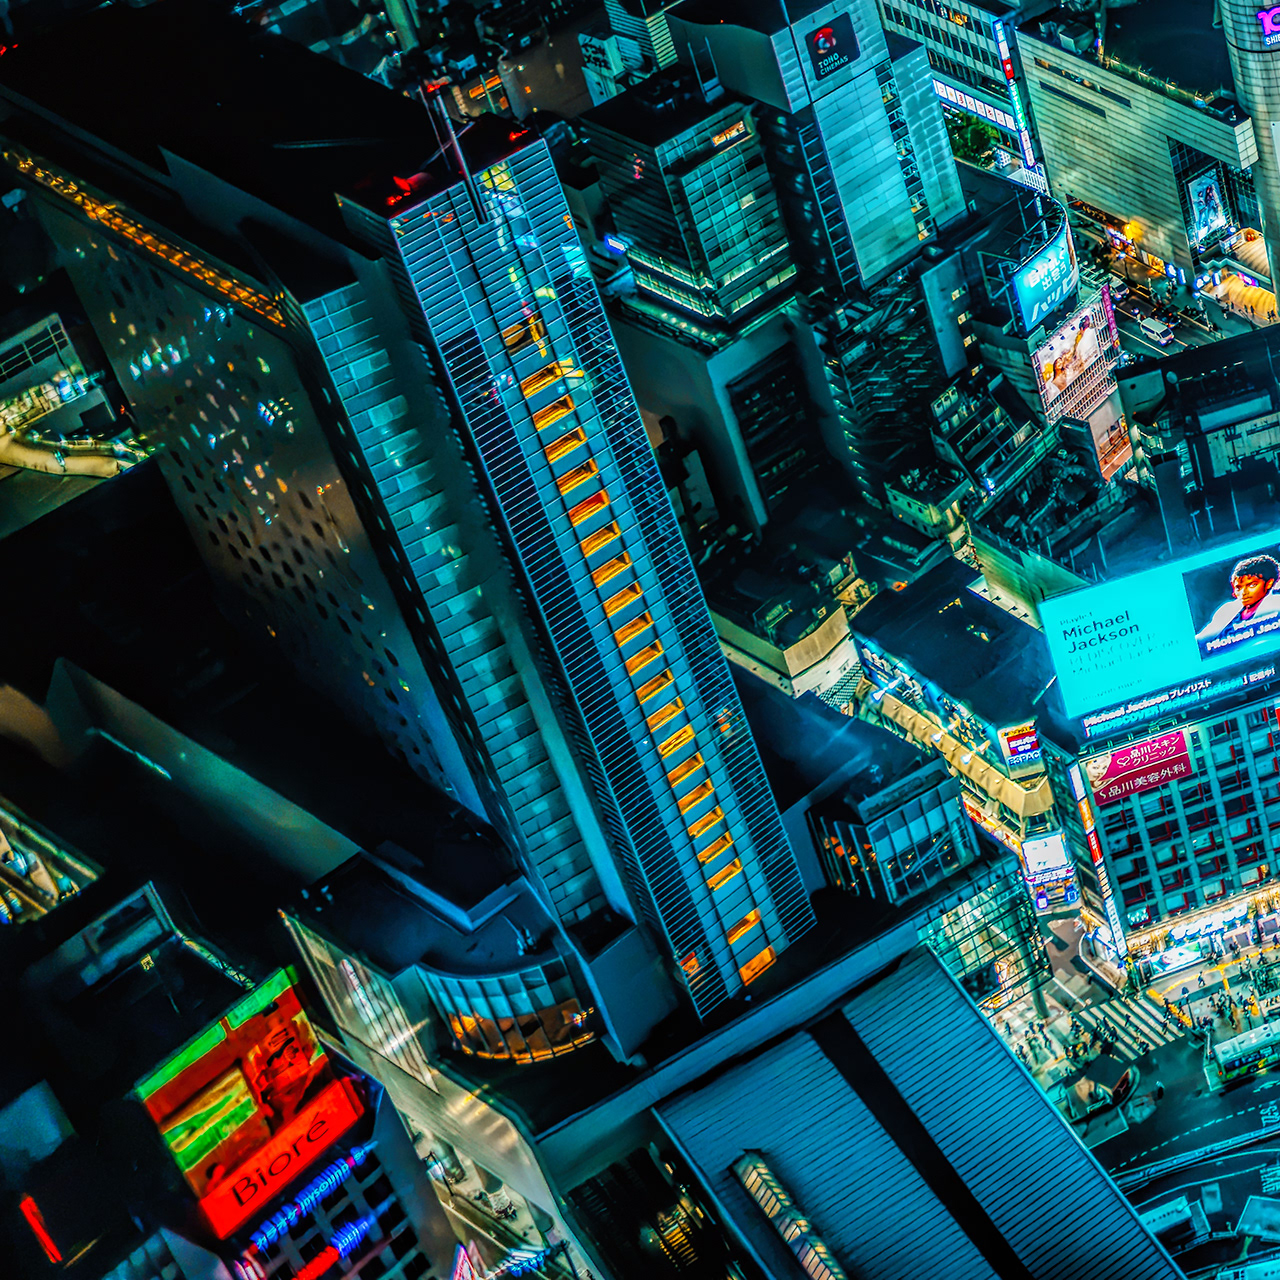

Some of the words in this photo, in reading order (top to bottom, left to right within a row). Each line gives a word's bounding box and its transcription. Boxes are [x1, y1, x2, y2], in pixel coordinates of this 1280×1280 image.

[817, 52, 840, 68] TOHO
[820, 55, 850, 77] CINEMAS
[1062, 610, 1131, 640] Michael
[1067, 623, 1140, 654] Jackson
[1206, 628, 1255, 651] Michael
[1129, 736, 1180, 759] 品川スキン
[1132, 746, 1177, 766] クリニック
[1107, 762, 1187, 797] 品川美容外科
[231, 1113, 329, 1209] Bioré
